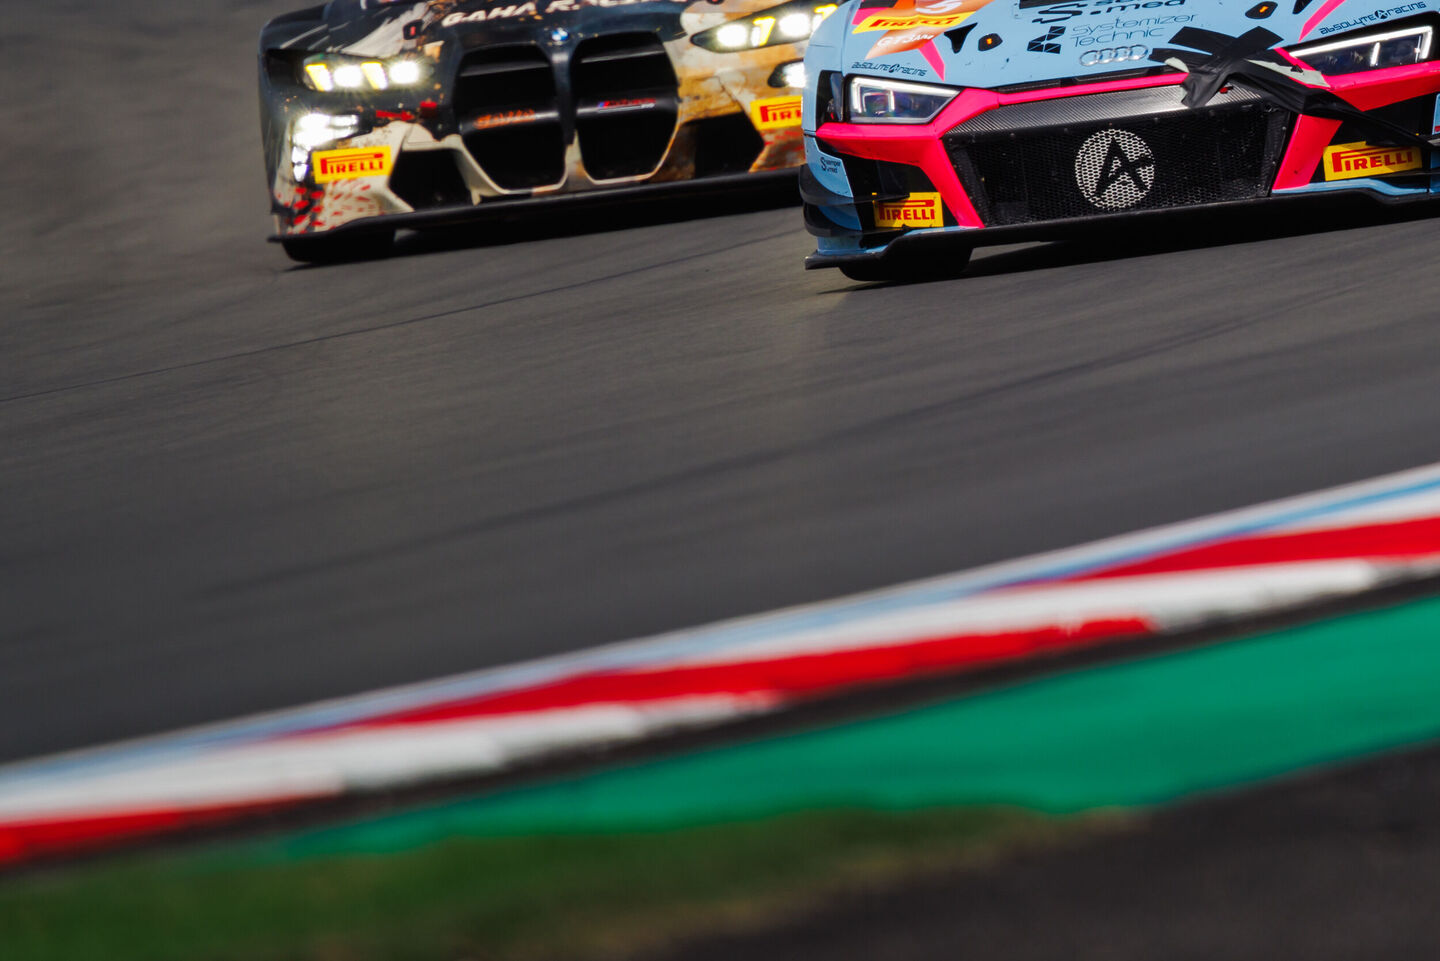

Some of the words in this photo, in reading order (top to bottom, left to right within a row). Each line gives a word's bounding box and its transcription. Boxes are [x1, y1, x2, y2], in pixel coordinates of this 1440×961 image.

[441, 0, 538, 28] GAHA
[320, 152, 385, 175] PIRELLI
[1331, 146, 1414, 173] PIRELLI
[879, 199, 935, 221] PIRELLI
